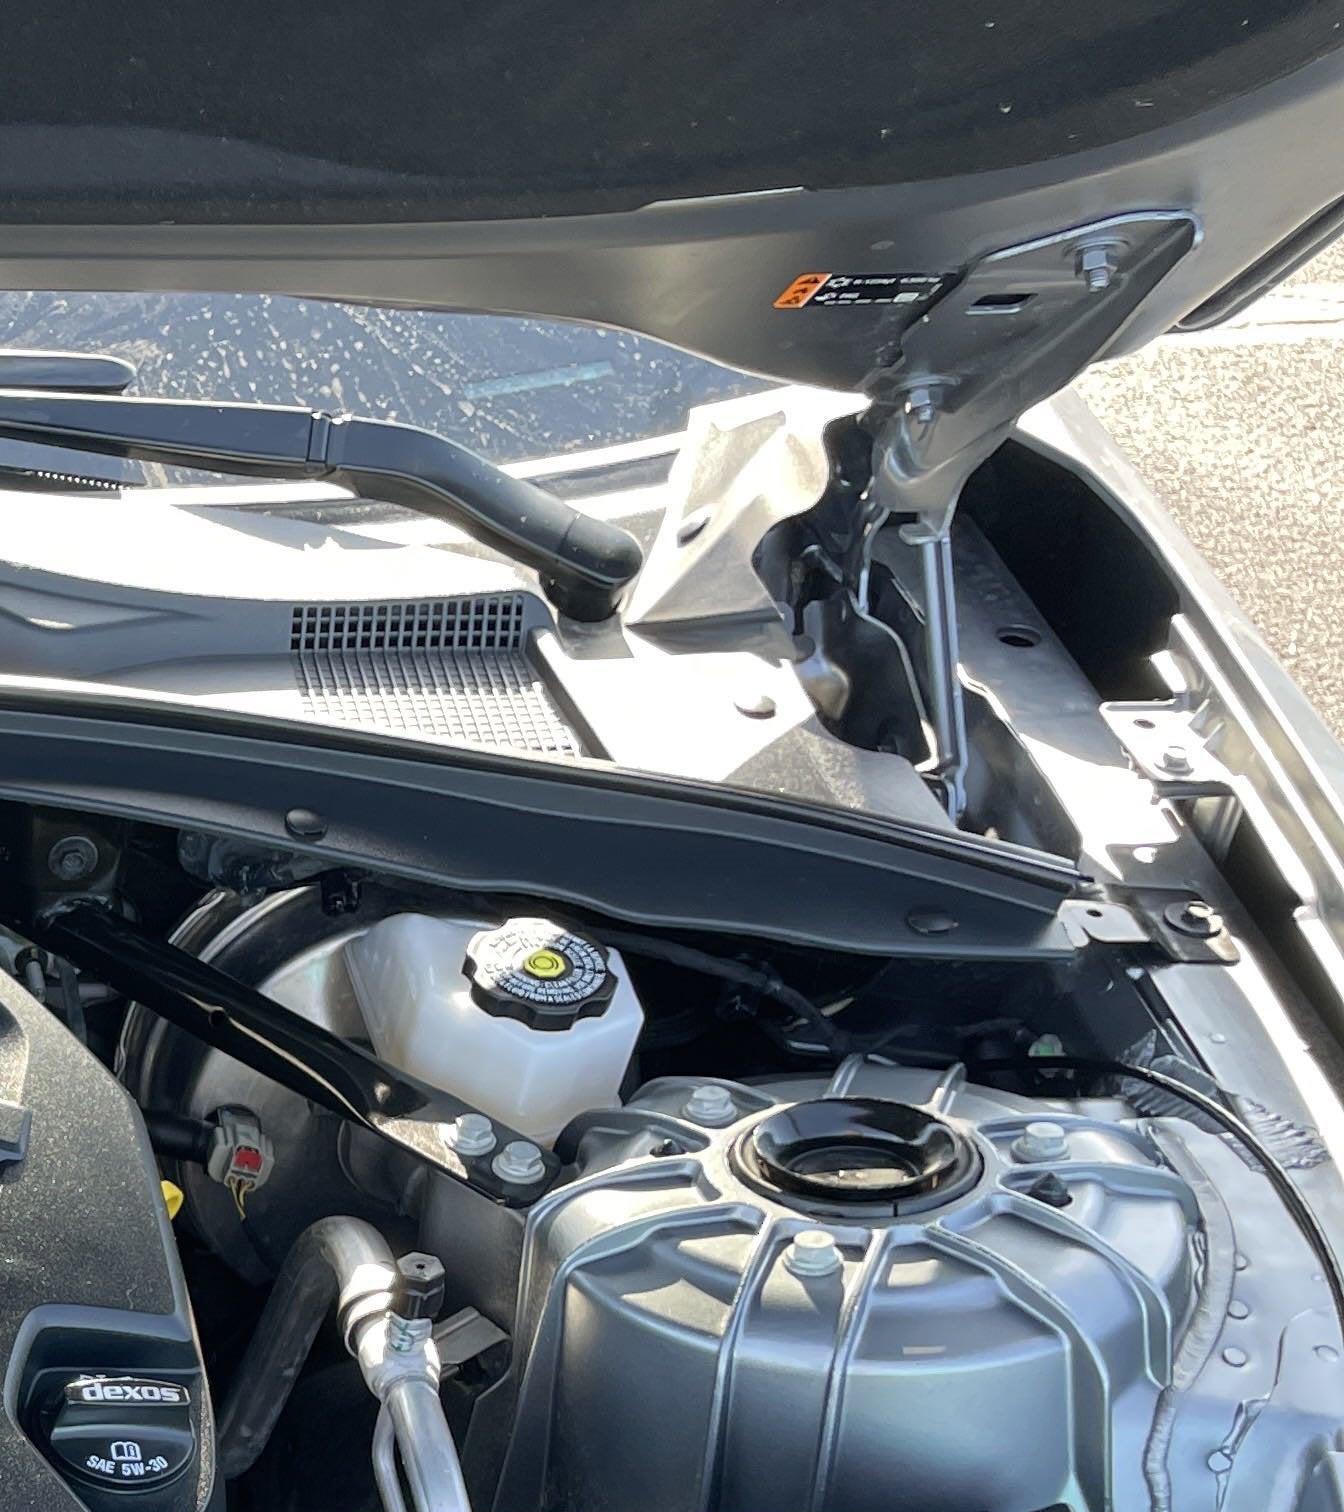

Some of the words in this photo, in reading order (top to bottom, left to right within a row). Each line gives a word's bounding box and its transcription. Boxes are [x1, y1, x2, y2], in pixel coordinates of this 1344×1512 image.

[82, 1382, 181, 1402] dexos
[86, 1455, 115, 1474] SAE
[121, 1455, 169, 1476] 5W-30
